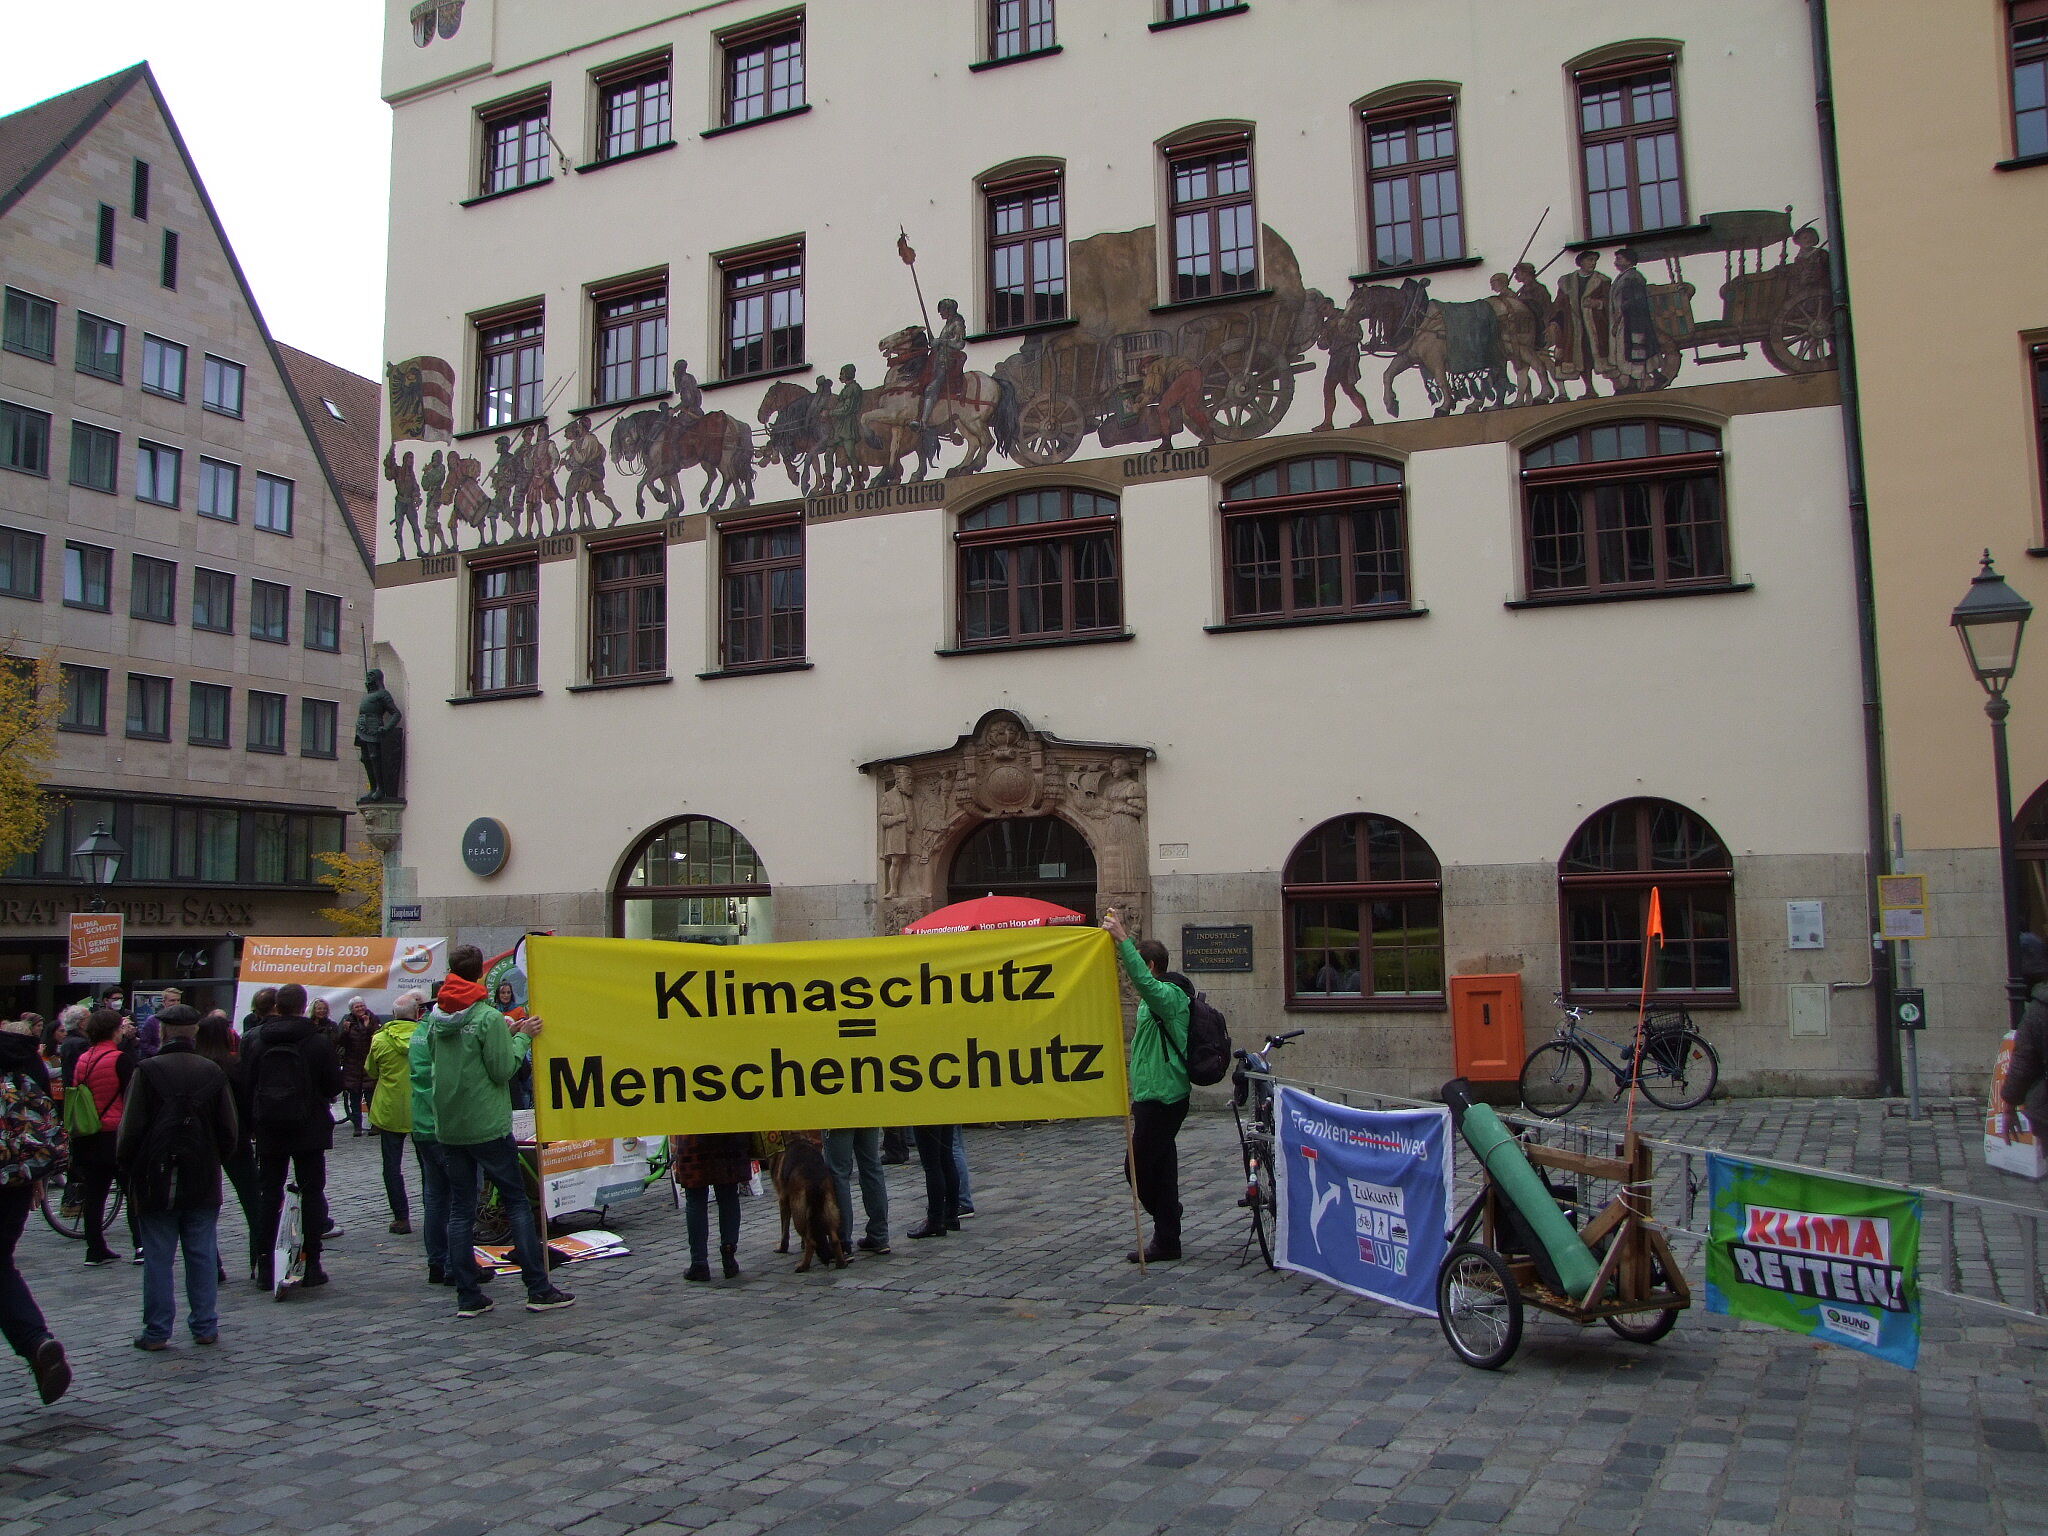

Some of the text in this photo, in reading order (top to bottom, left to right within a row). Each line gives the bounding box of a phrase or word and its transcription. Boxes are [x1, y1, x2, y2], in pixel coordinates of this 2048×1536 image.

[468, 847, 499, 856] PEACH
[73, 920, 99, 930] KLIMA
[85, 923, 118, 935] SCHUTZ
[980, 922, 996, 930] Hop
[1010, 919, 1026, 928] Hop
[1028, 917, 1041, 926] off
[88, 936, 119, 948] GEMEIN
[1196, 932, 1240, 940] INDUSTRIE-
[253, 944, 369, 959] Nürnberg bis 2030
[1186, 947, 1248, 956] HANDELSKAMMER
[250, 959, 383, 974] klimaneutral machen
[655, 958, 1056, 1019] Klimaschutz
[550, 1033, 1105, 1110] Menschenschutz
[1291, 1109, 1428, 1161] Frankenschnellweg
[1352, 1184, 1399, 1207] Zukunft
[1747, 1208, 1884, 1261] KLIMA
[1377, 1243, 1390, 1265] U
[1733, 1247, 1902, 1310] RETTEN!
[1841, 1314, 1870, 1330] BUND
